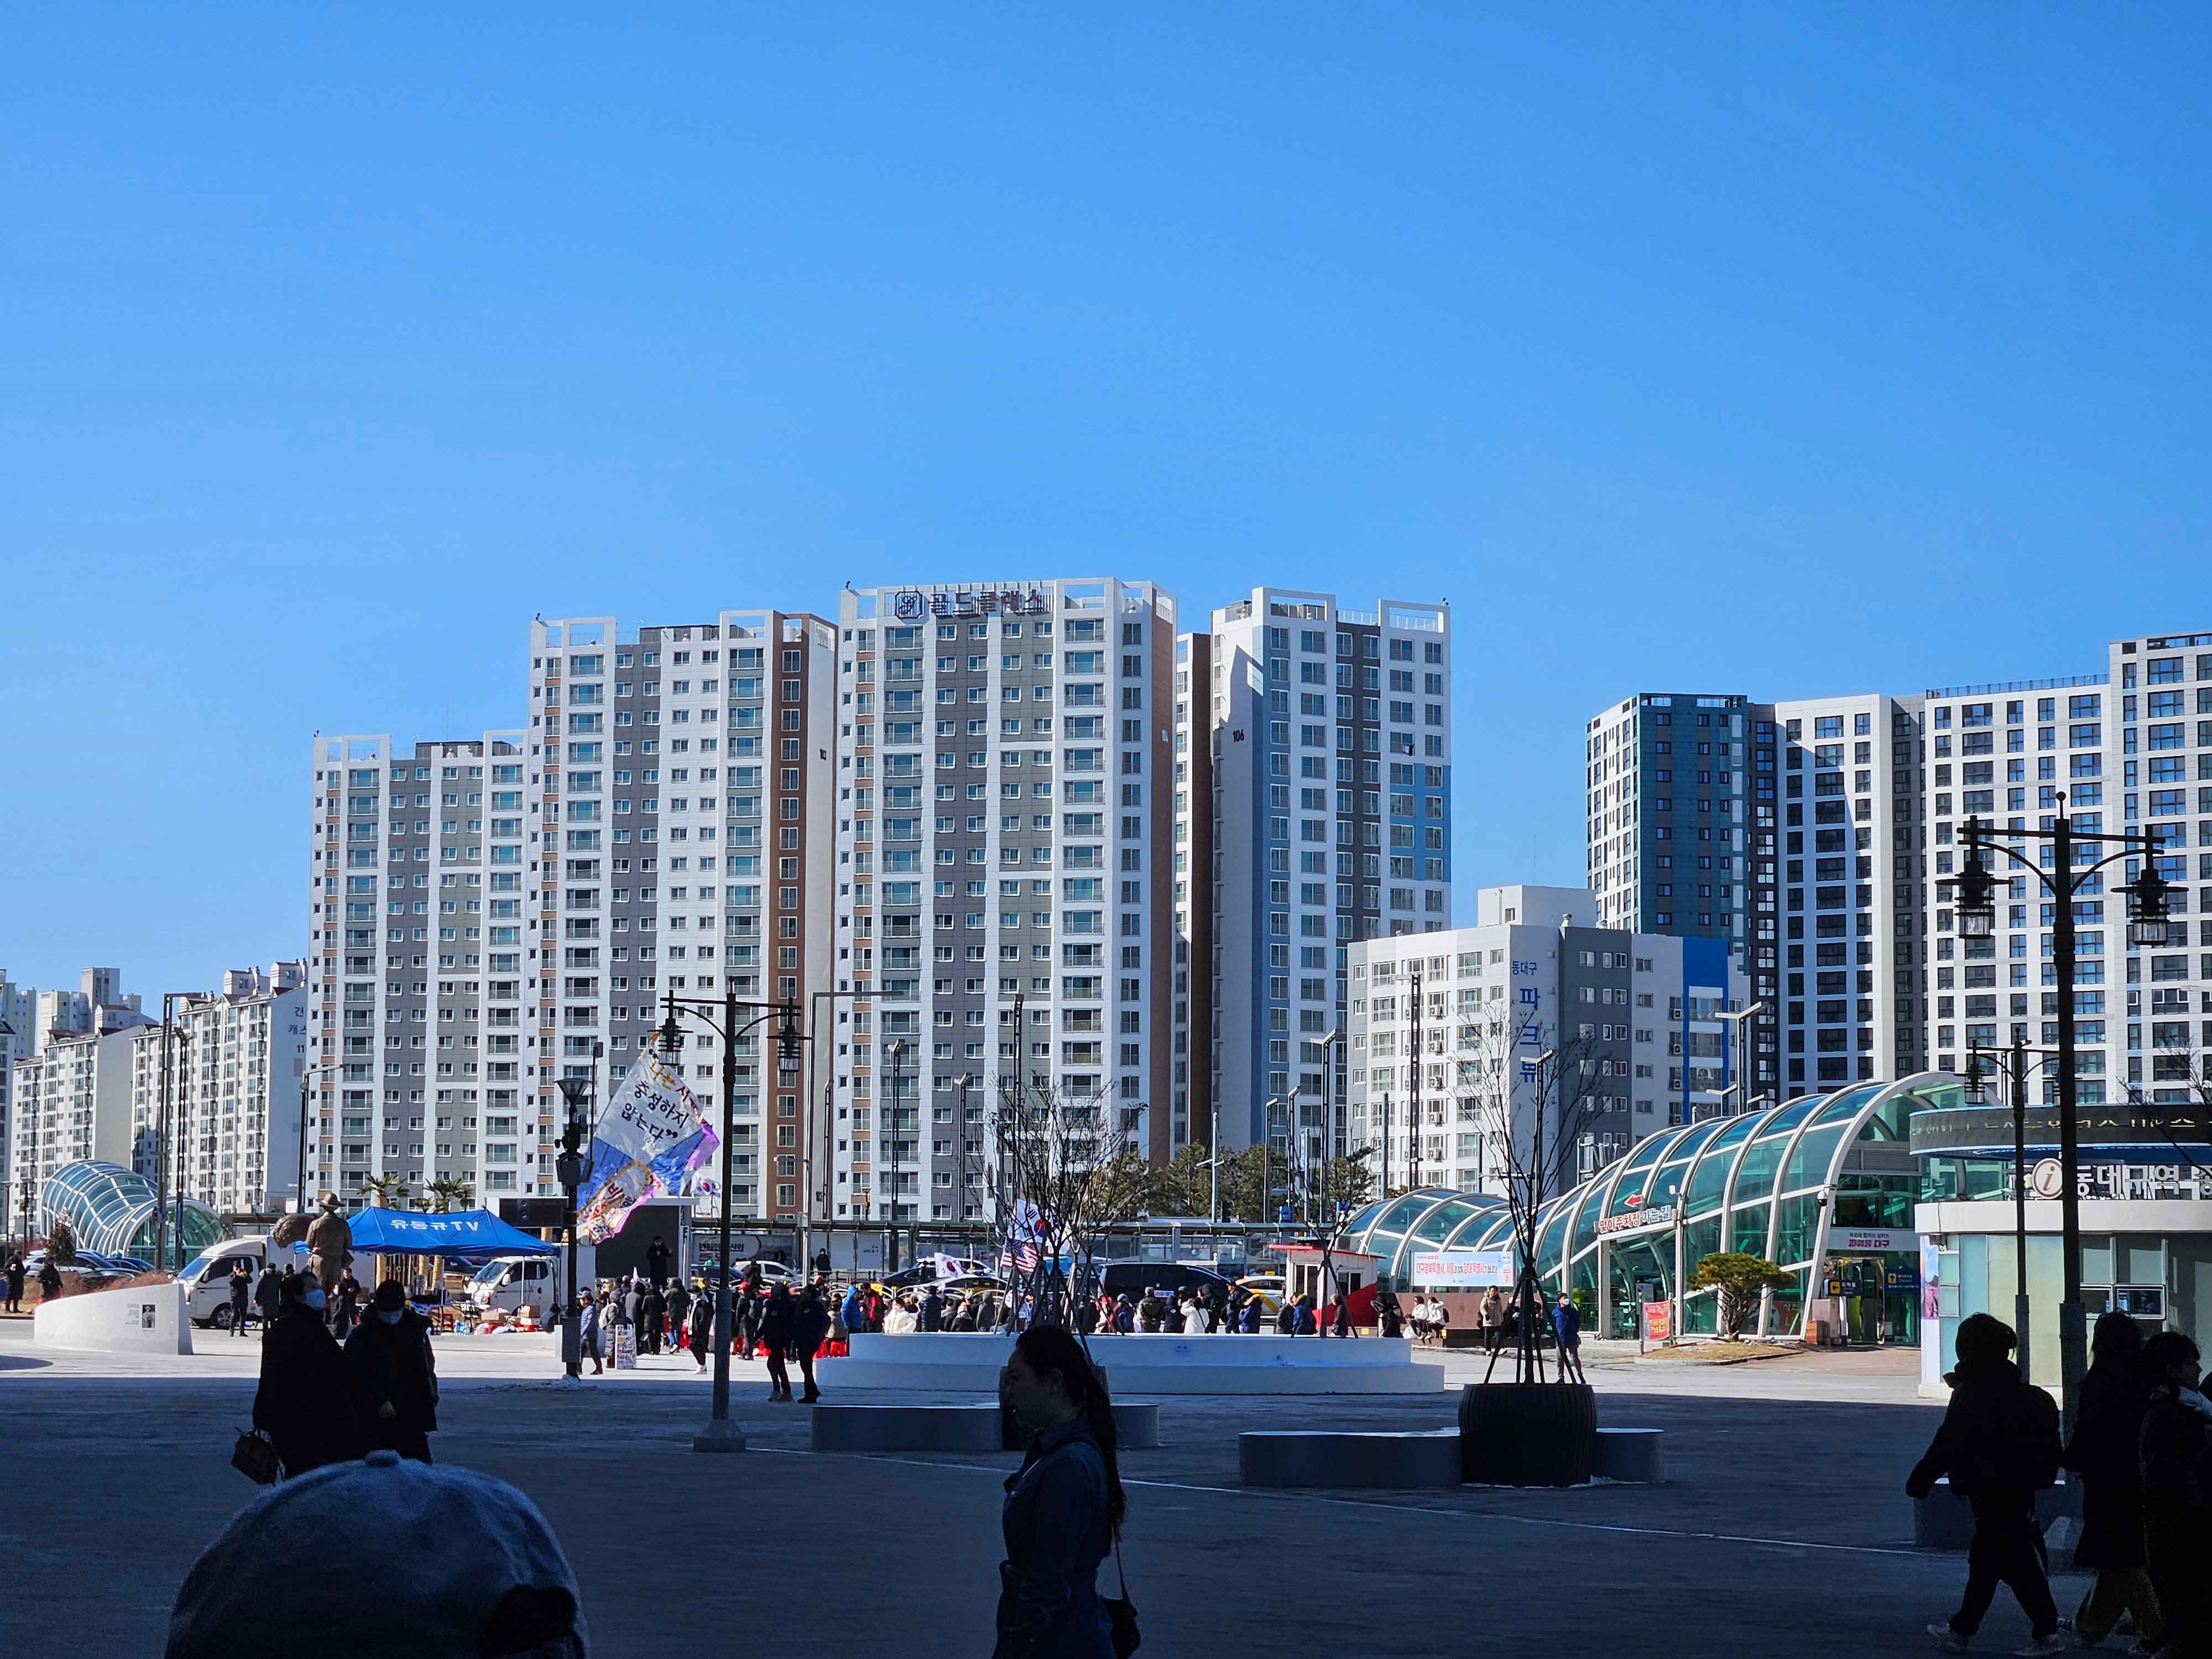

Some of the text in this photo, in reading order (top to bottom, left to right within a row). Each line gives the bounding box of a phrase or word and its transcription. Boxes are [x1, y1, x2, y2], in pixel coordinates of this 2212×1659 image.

[928, 589, 1045, 614] 골드클래스
[1232, 729, 1245, 743] 106
[1511, 961, 1537, 975] 동대구
[634, 1079, 690, 1129] 충성하지
[1599, 1205, 1672, 1234] 맞이주차장 가는 길
[1874, 1239, 1890, 1248] 대구
